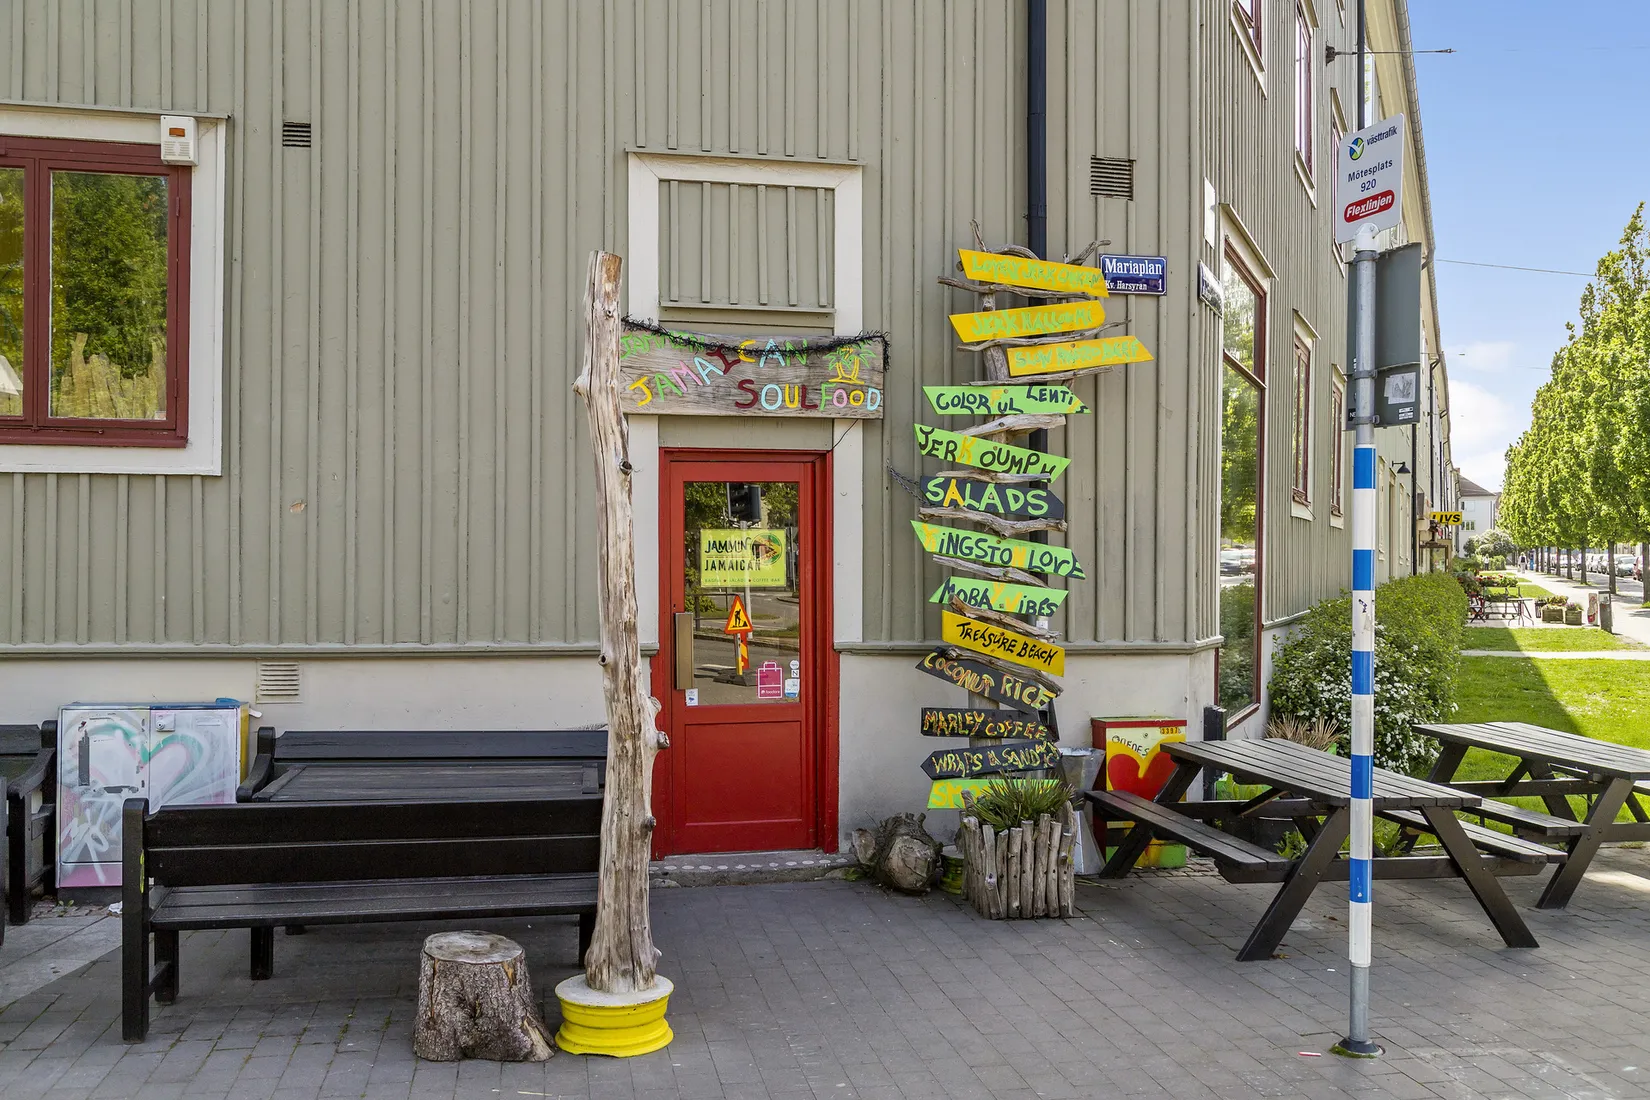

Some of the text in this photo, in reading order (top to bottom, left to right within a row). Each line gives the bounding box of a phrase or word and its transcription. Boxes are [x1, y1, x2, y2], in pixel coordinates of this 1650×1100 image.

[1366, 126, 1398, 146] västtrafik
[1348, 160, 1393, 182] Mötesplats
[1360, 178, 1377, 192] 920
[1346, 194, 1393, 218] Flexlinjen
[1104, 258, 1163, 277] Mariaplan
[1105, 279, 1163, 291] Kv. Harsyran 1
[918, 427, 977, 466] JERK
[926, 477, 1049, 516] SALADS
[704, 559, 761, 571] JAMAICAN
[956, 620, 1057, 667] TREASURE BEACH
[923, 651, 1056, 710] COCONUT RICE
[923, 710, 1049, 741] MARLEY COFFEE
[932, 751, 984, 778] WRAPS
